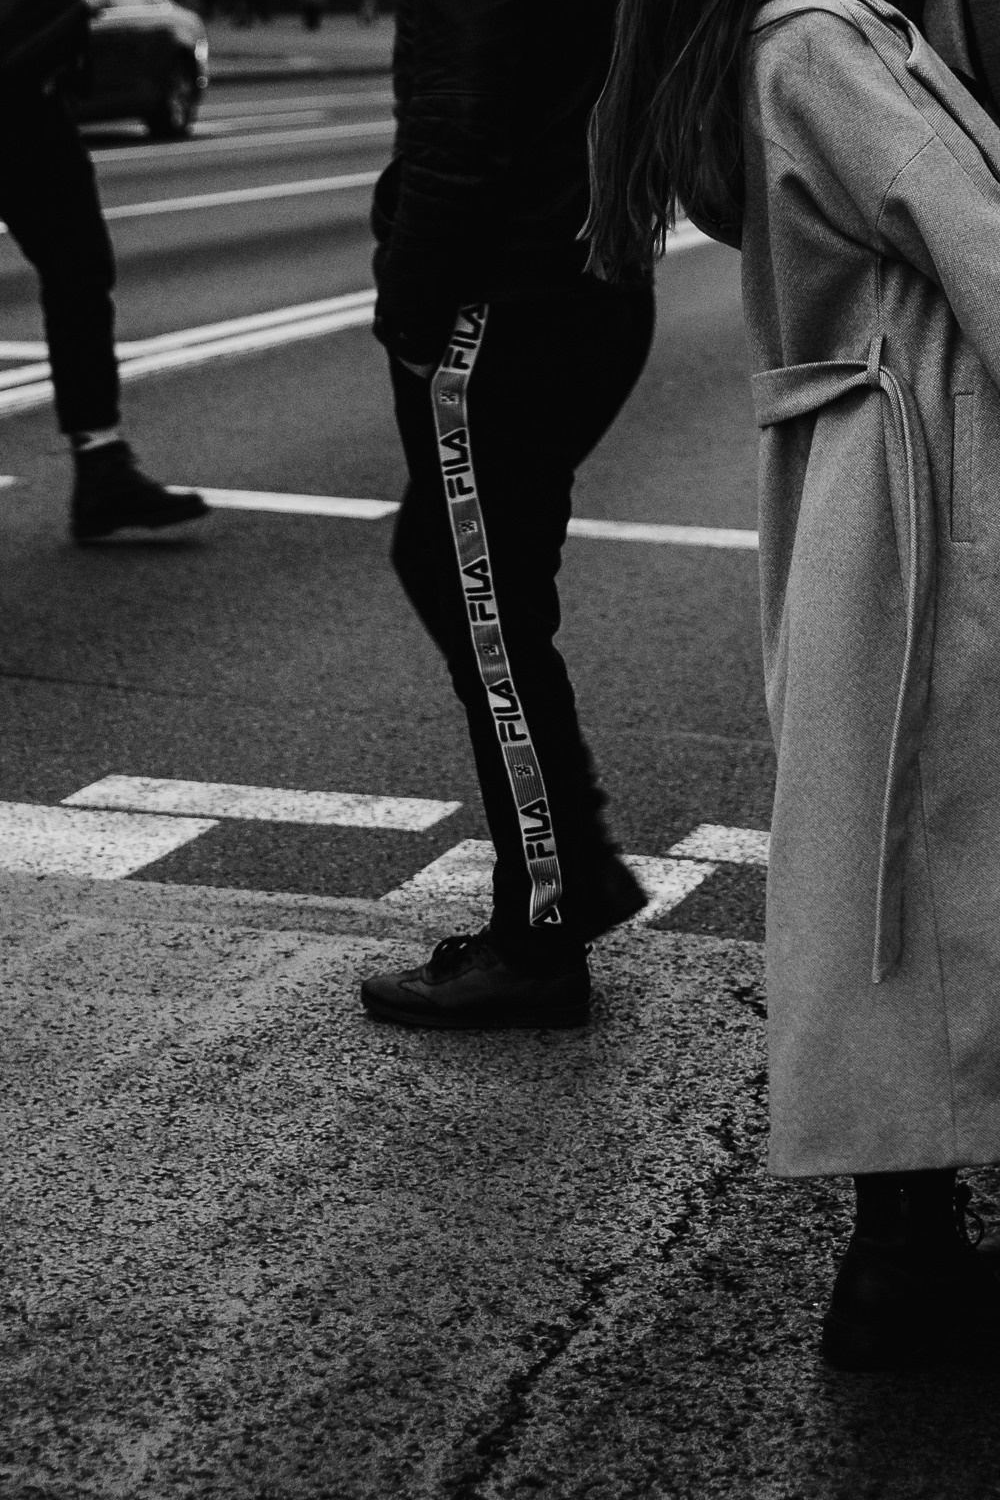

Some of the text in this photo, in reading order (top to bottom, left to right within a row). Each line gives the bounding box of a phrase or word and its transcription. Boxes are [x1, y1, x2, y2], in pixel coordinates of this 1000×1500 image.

[443, 304, 487, 370] FILA
[440, 429, 475, 499] FILA
[462, 558, 497, 622] FILA
[489, 679, 528, 743] FILA
[520, 799, 556, 860] FILA
